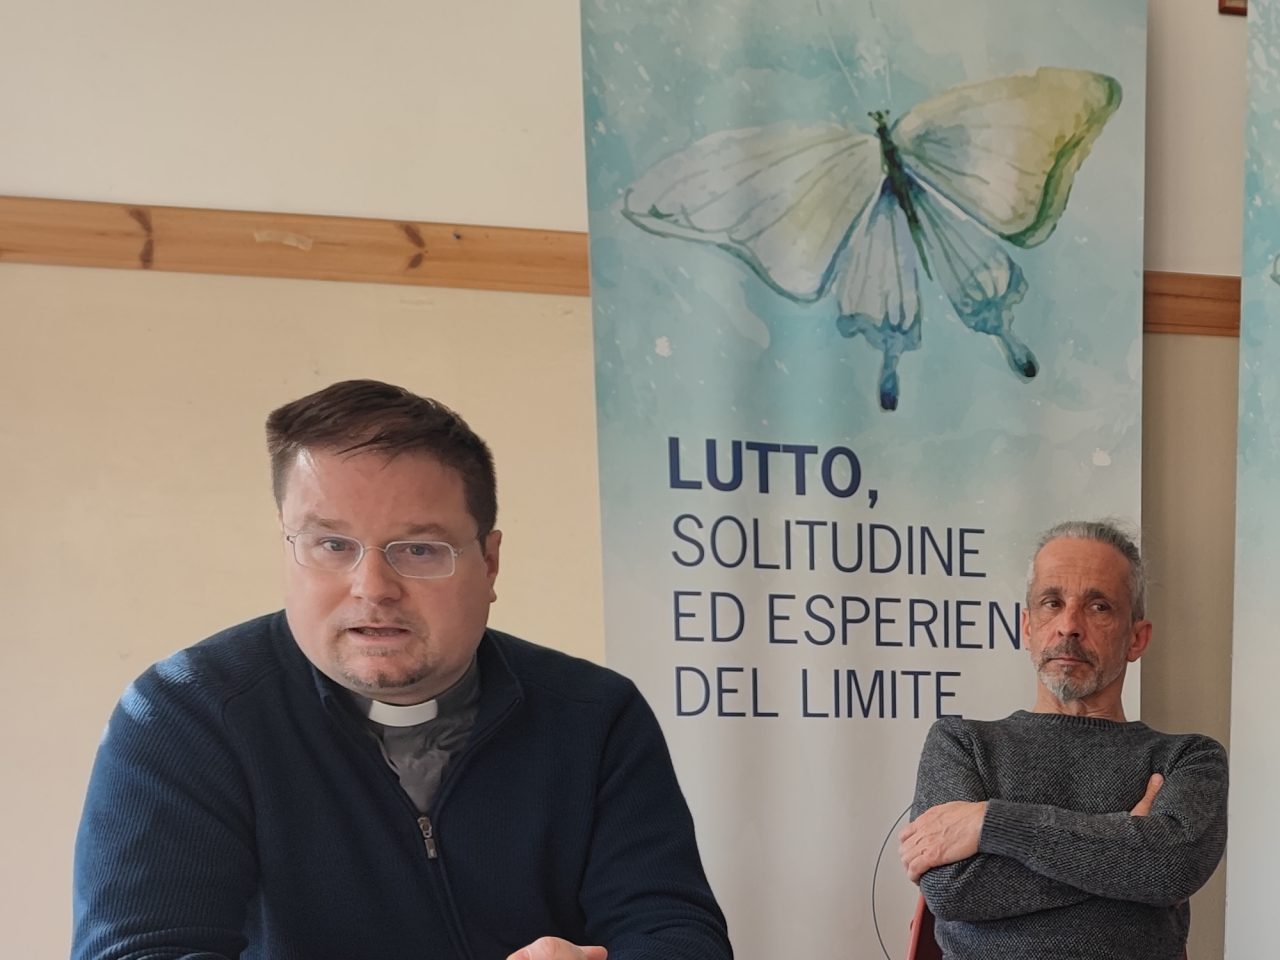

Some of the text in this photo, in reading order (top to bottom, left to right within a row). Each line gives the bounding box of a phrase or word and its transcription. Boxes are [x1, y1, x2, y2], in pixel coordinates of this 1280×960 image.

[667, 436, 878, 509] LUTTO,
[671, 513, 987, 578] SOLITUDINE
[673, 590, 1021, 649] ED ESPERIEN
[675, 666, 963, 719] DEL LIMITE
